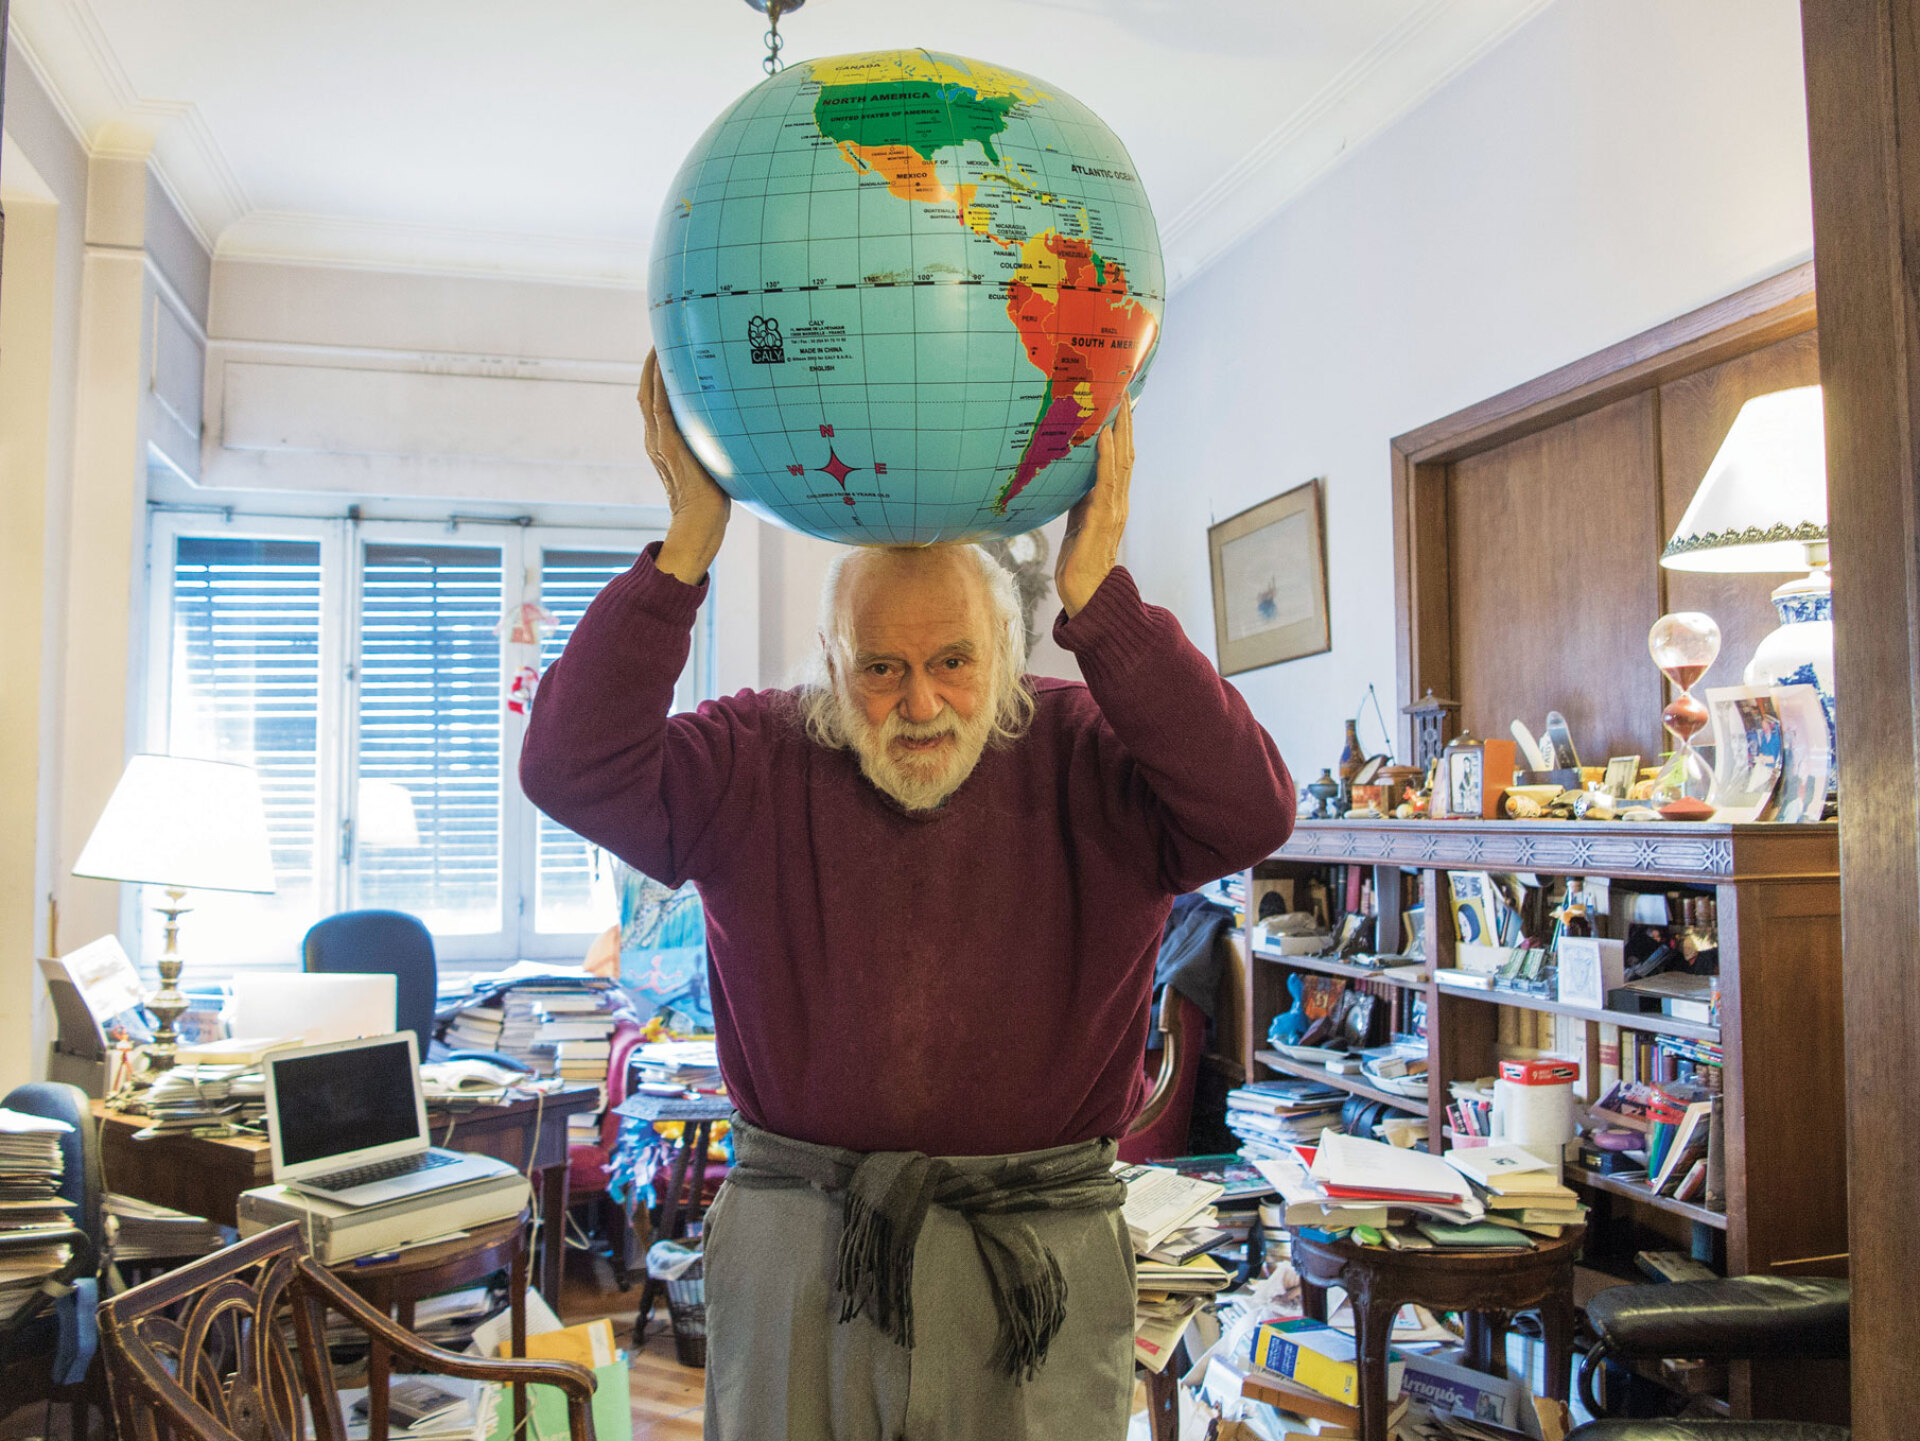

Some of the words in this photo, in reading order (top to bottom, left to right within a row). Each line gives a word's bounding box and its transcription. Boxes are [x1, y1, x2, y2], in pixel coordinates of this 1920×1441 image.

[835, 63, 881, 71] CANADA
[822, 95, 867, 106] NORTH
[870, 92, 931, 102] AMERICA
[861, 112, 890, 120] STATES
[1071, 164, 1114, 179] ATLANTIC
[1000, 262, 1033, 270] COLOMBIA
[812, 278, 827, 286] 120°
[1071, 337, 1105, 348] SOUTH
[1111, 338, 1138, 349] AMERI
[753, 350, 782, 362] CALY
[819, 424, 834, 438] N
[786, 464, 804, 476] W
[875, 463, 888, 475] E
[843, 496, 856, 506] S
